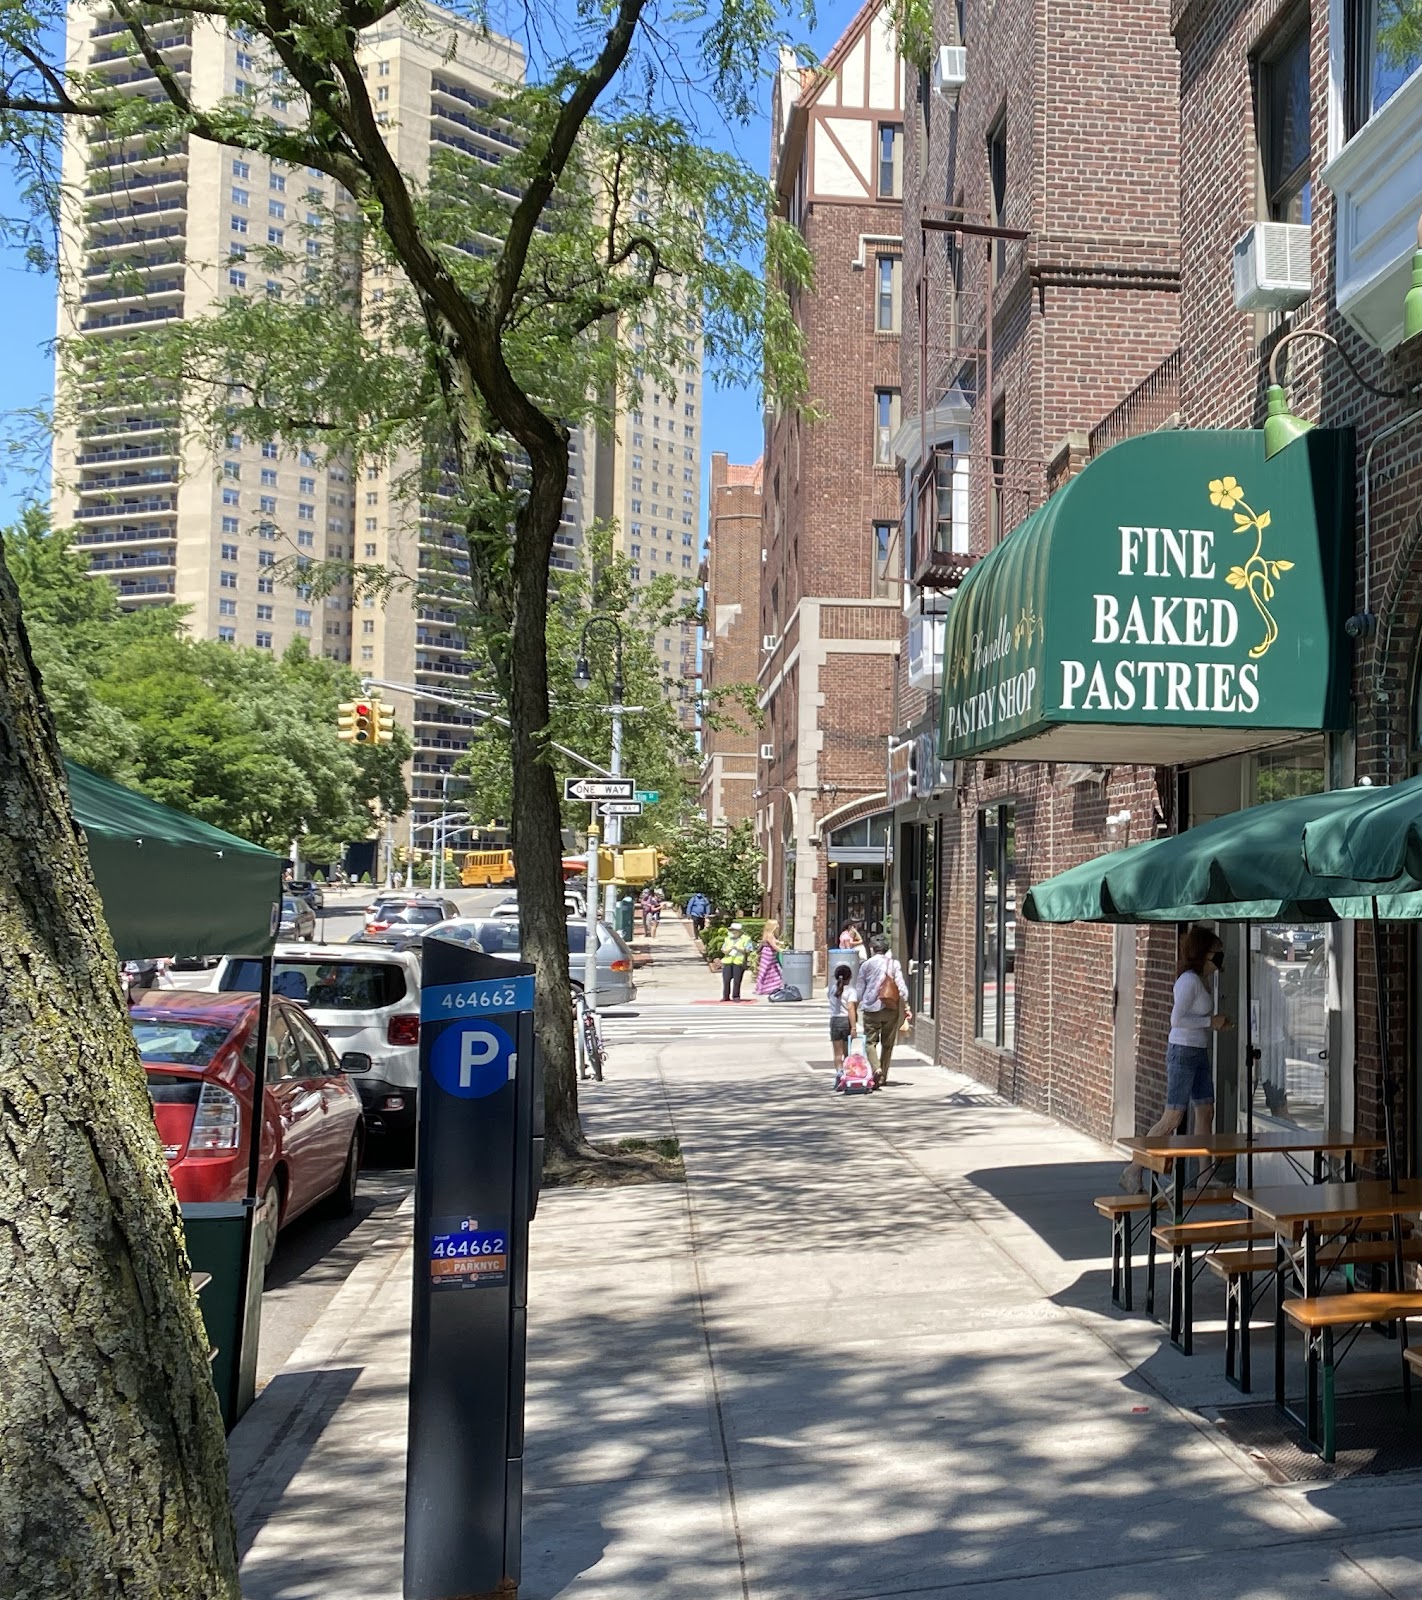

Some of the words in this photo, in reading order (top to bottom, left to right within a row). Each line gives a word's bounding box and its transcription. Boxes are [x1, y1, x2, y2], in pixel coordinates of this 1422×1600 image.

[1118, 526, 1216, 579] FINE
[1092, 594, 1238, 648] BAKED
[947, 686, 996, 741] PASTRY
[998, 667, 1036, 722] SHOP
[1059, 660, 1260, 713] PASTRIES
[576, 786, 595, 794] ONE
[605, 786, 625, 794] WAY
[441, 990, 515, 1009] 464662
[459, 1031, 499, 1087] P
[433, 1239, 504, 1257] 464662
[454, 1261, 500, 1272] PARKNYC
